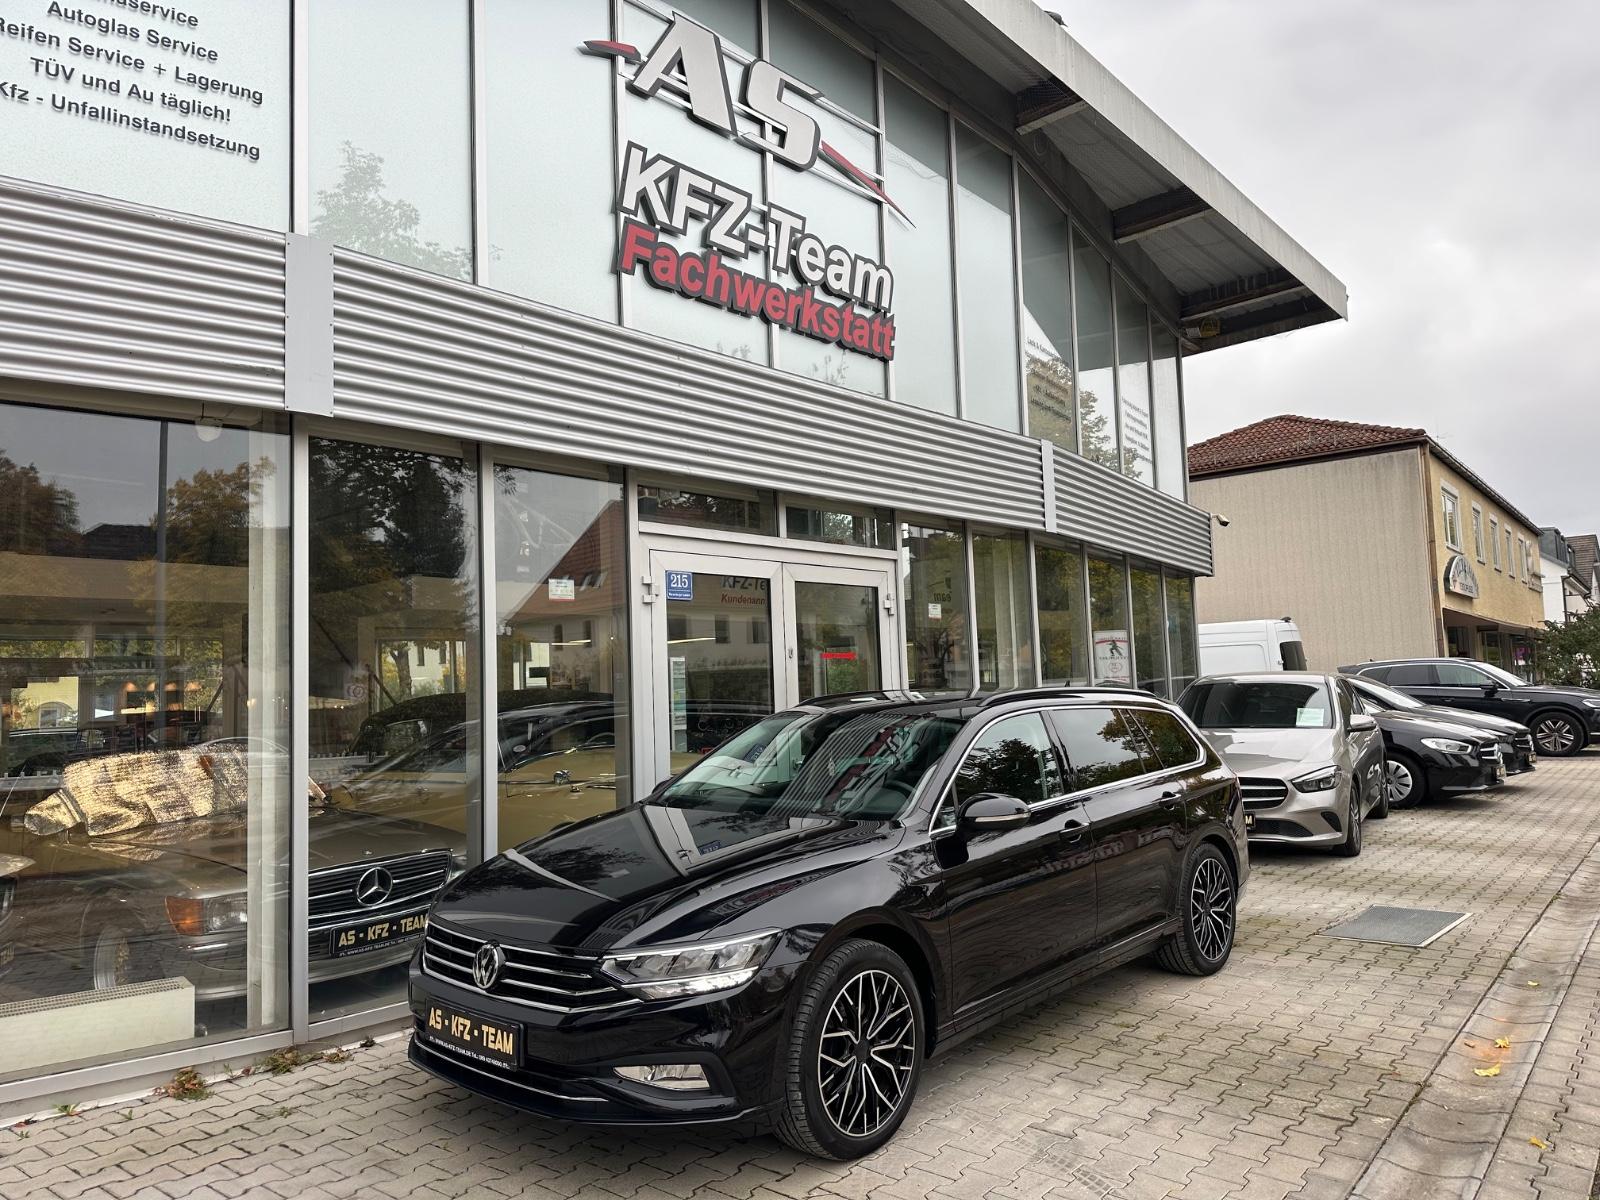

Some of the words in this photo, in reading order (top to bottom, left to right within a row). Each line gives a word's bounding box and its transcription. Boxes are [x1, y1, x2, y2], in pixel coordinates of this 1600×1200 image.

[0, 17, 60, 47] Reifen
[68, 37, 145, 70] Service
[154, 63, 167, 76] +
[175, 66, 263, 104] Lagerung
[47, 1, 140, 39] Autoglas
[147, 29, 219, 61] Service
[0, 81, 29, 102] Kfz
[51, 93, 260, 161] Unfallinstandsetzung
[30, 56, 75, 81] TÜV
[82, 72, 120, 94] und
[128, 83, 153, 102] Au
[161, 92, 231, 122] täglich!
[627, 11, 823, 172] AS
[615, 140, 894, 313] KFZ-Team
[612, 217, 896, 361] Fachwerkstatt
[670, 573, 689, 588] 215
[338, 930, 355, 947] AS
[367, 922, 390, 941] KFZ
[429, 1007, 442, 1030] AS
[451, 1014, 471, 1041] KFZ
[481, 1024, 513, 1055] TEAM
